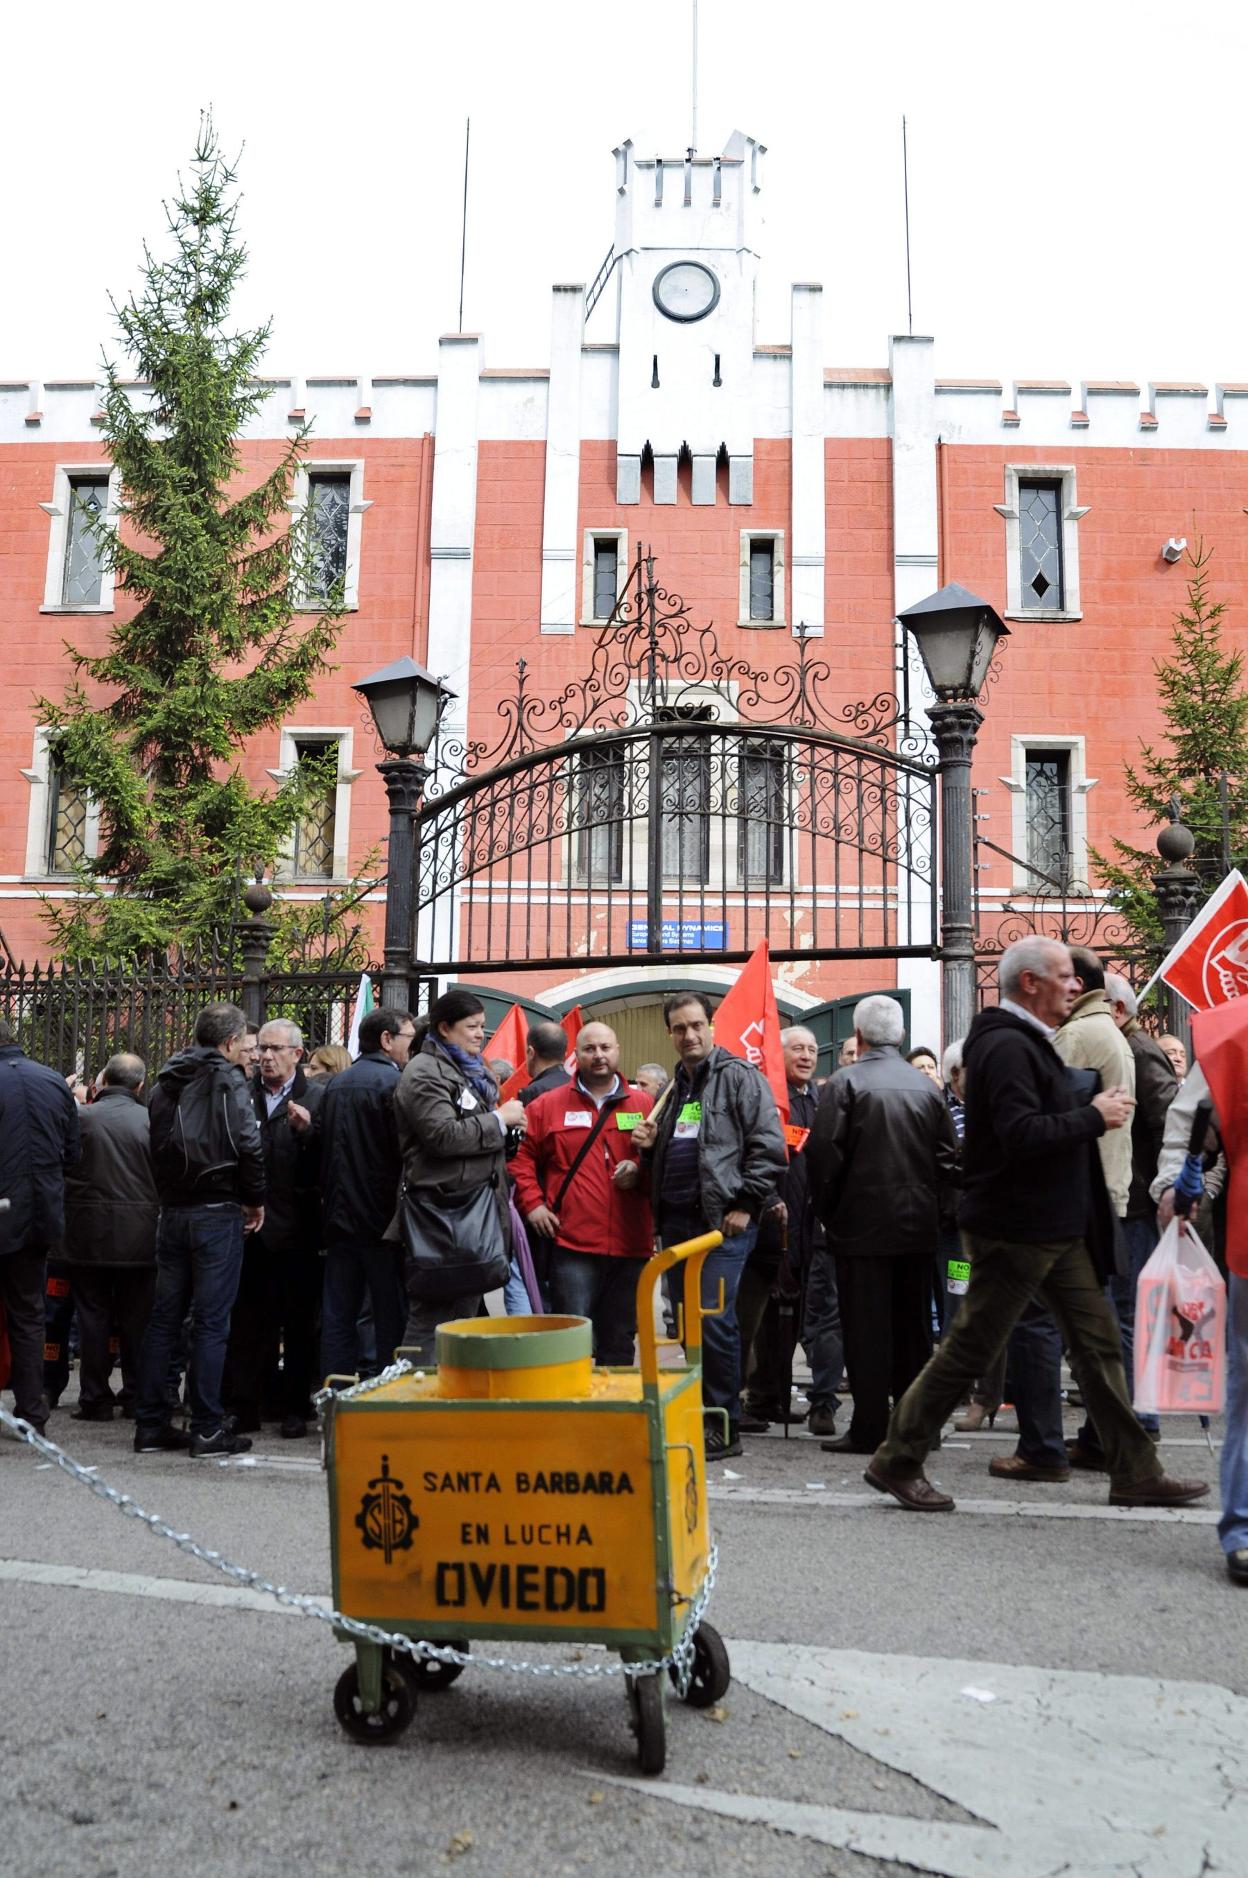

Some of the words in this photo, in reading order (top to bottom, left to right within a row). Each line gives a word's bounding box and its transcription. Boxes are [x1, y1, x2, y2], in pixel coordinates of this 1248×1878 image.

[957, 1263, 970, 1271] NO
[423, 1471, 501, 1493] SANTA
[516, 1471, 634, 1494] BARBARA
[461, 1523, 489, 1545] EN
[504, 1524, 593, 1545] LUCHA
[436, 1561, 606, 1612] OVIEDO
